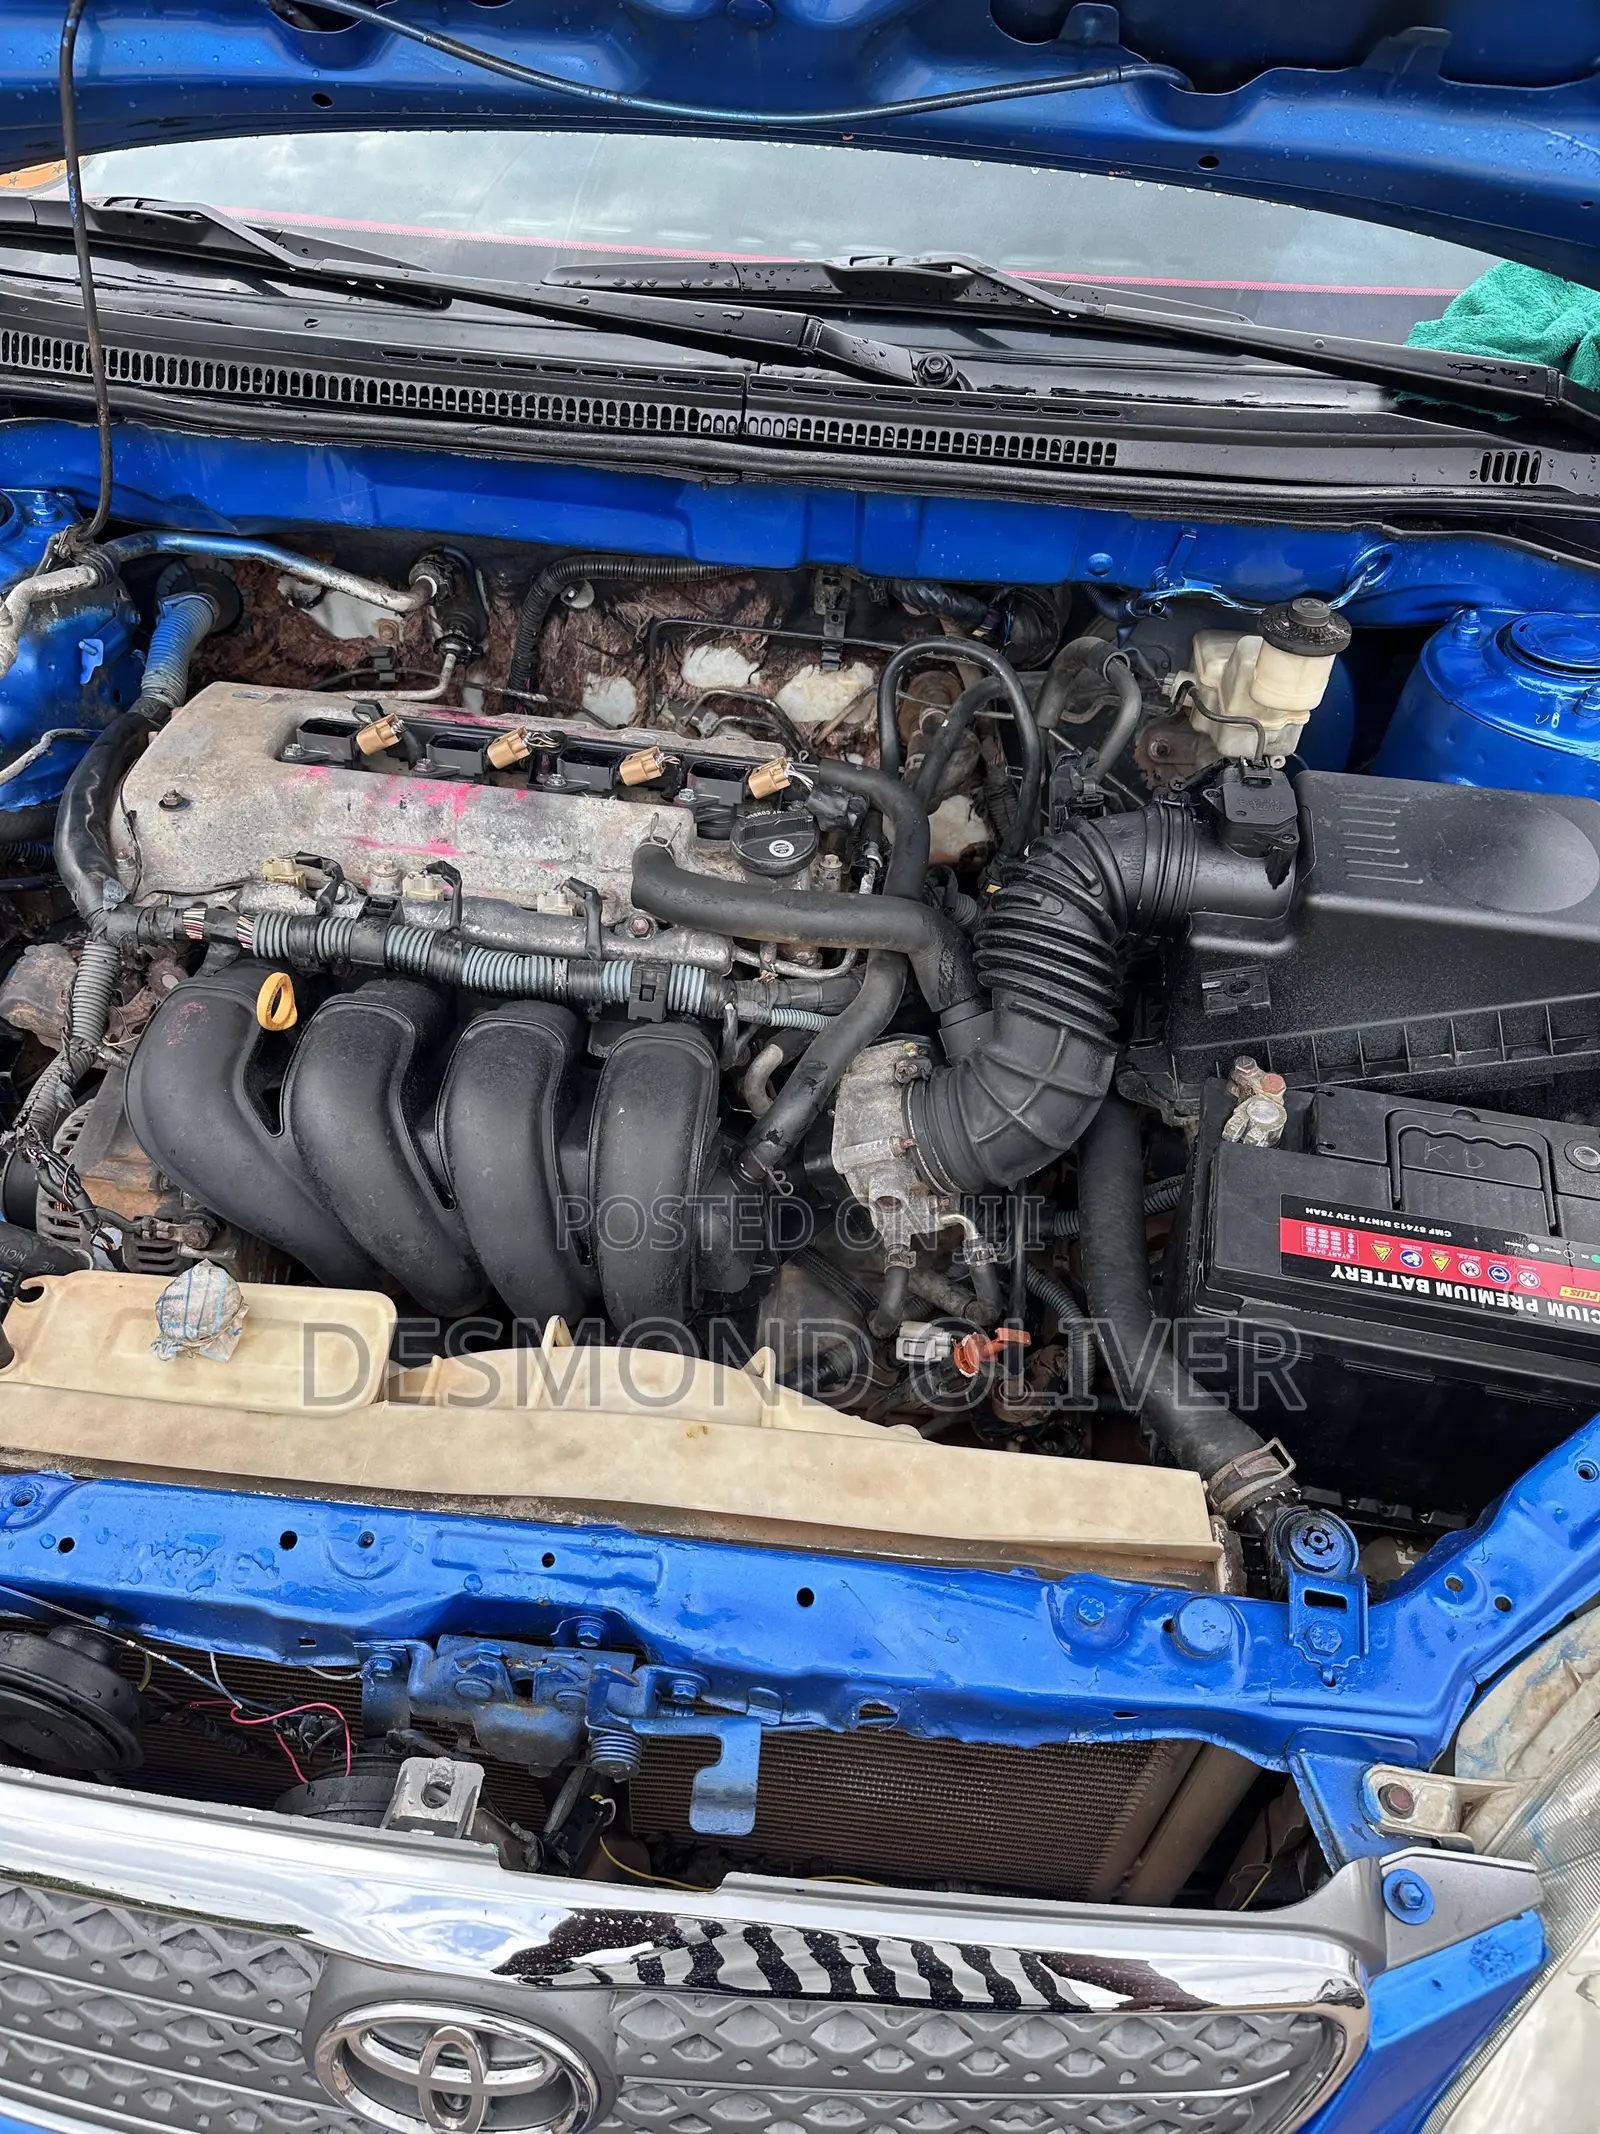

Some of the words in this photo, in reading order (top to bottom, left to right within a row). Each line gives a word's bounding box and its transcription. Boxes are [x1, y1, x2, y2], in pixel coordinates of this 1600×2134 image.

[1305, 1207, 1334, 1218] 75AH
[1335, 1212, 1356, 1222] 12V
[1393, 1221, 1426, 1234] 57413
[1426, 1228, 1452, 1238] CMF
[1330, 1264, 1430, 1294] BATTERY
[1435, 1281, 1539, 1313] PREMIUM
